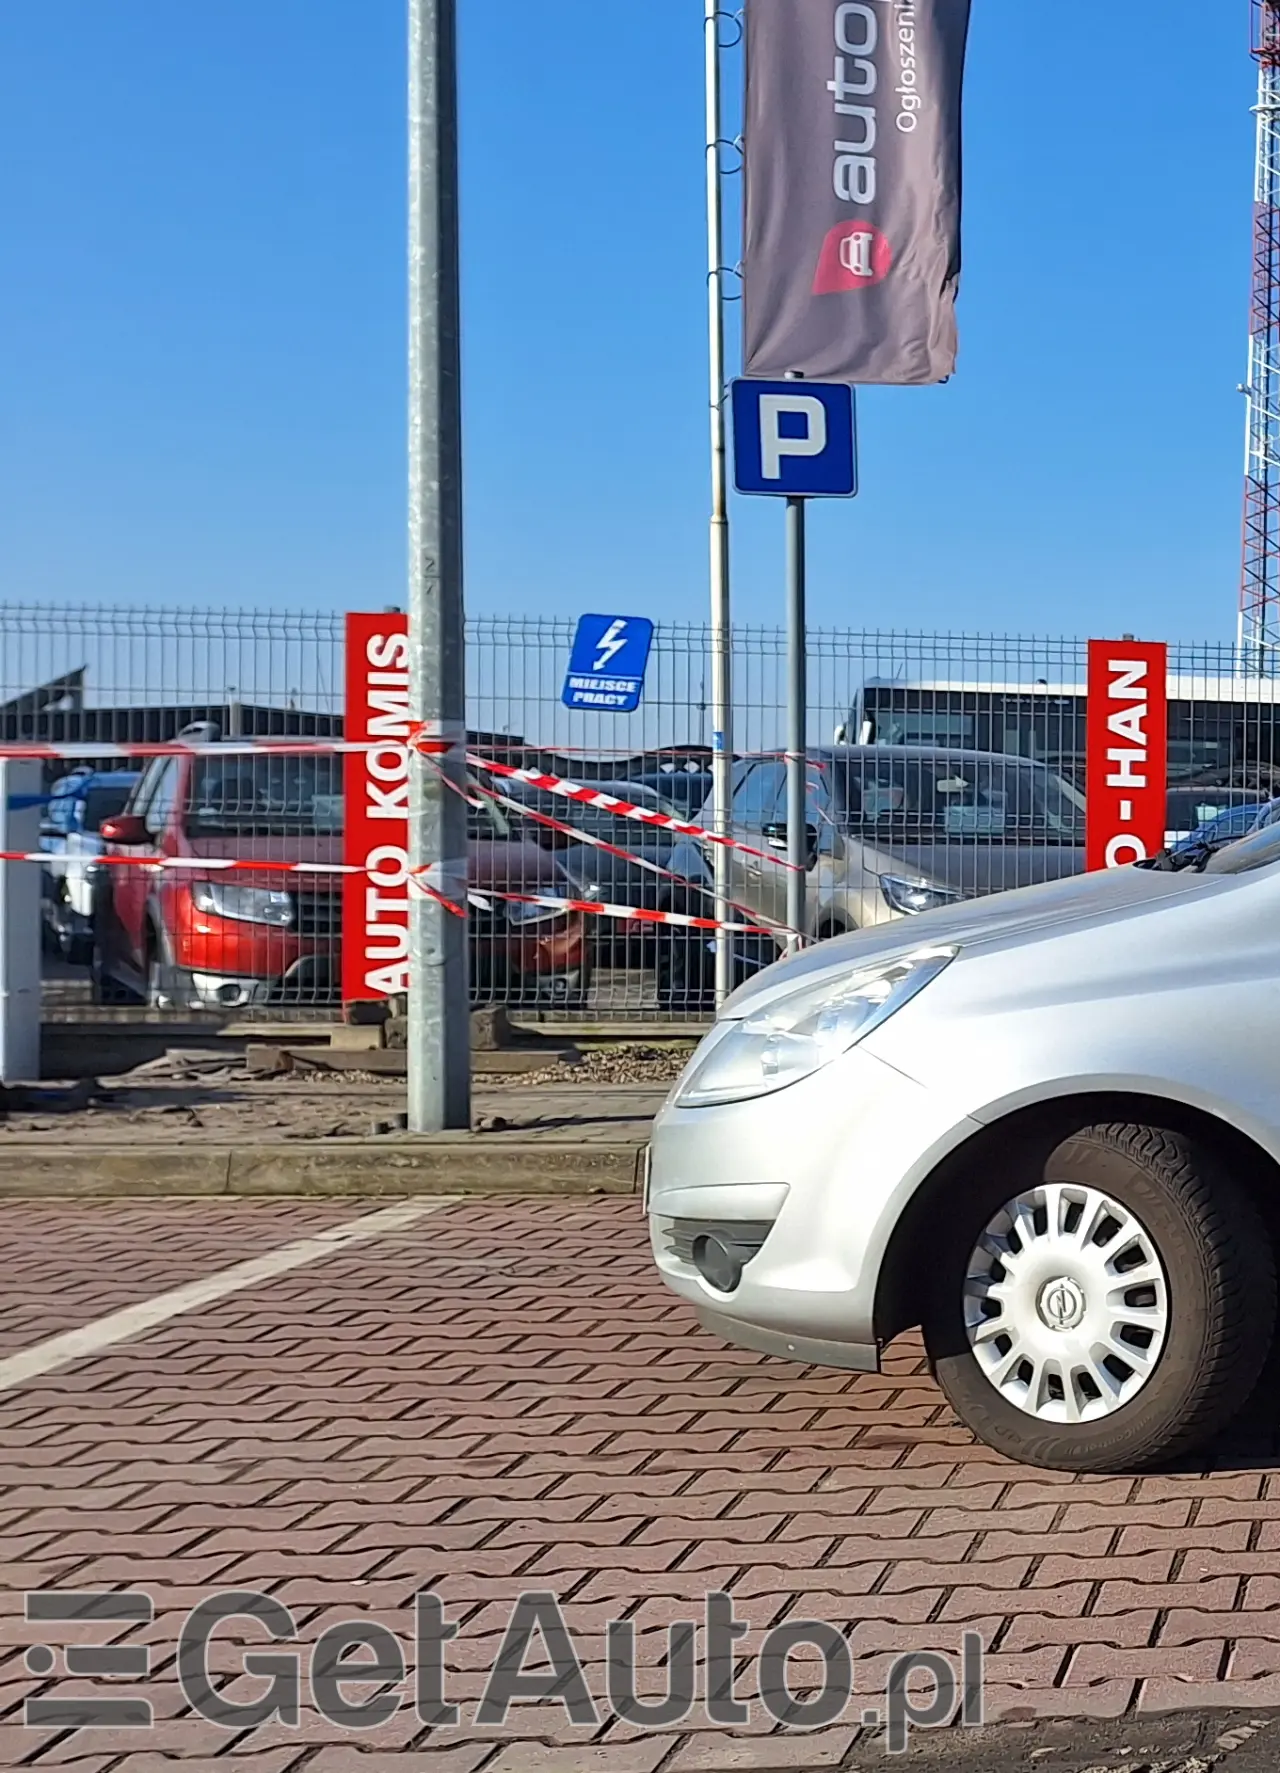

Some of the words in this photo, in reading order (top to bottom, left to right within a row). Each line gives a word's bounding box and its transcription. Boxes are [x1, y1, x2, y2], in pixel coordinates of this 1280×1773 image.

[826, 0, 881, 204] auto
[758, 393, 828, 480] P
[365, 632, 409, 818] KOMIS
[572, 691, 628, 706] PRACY
[364, 845, 409, 995] AUTO
